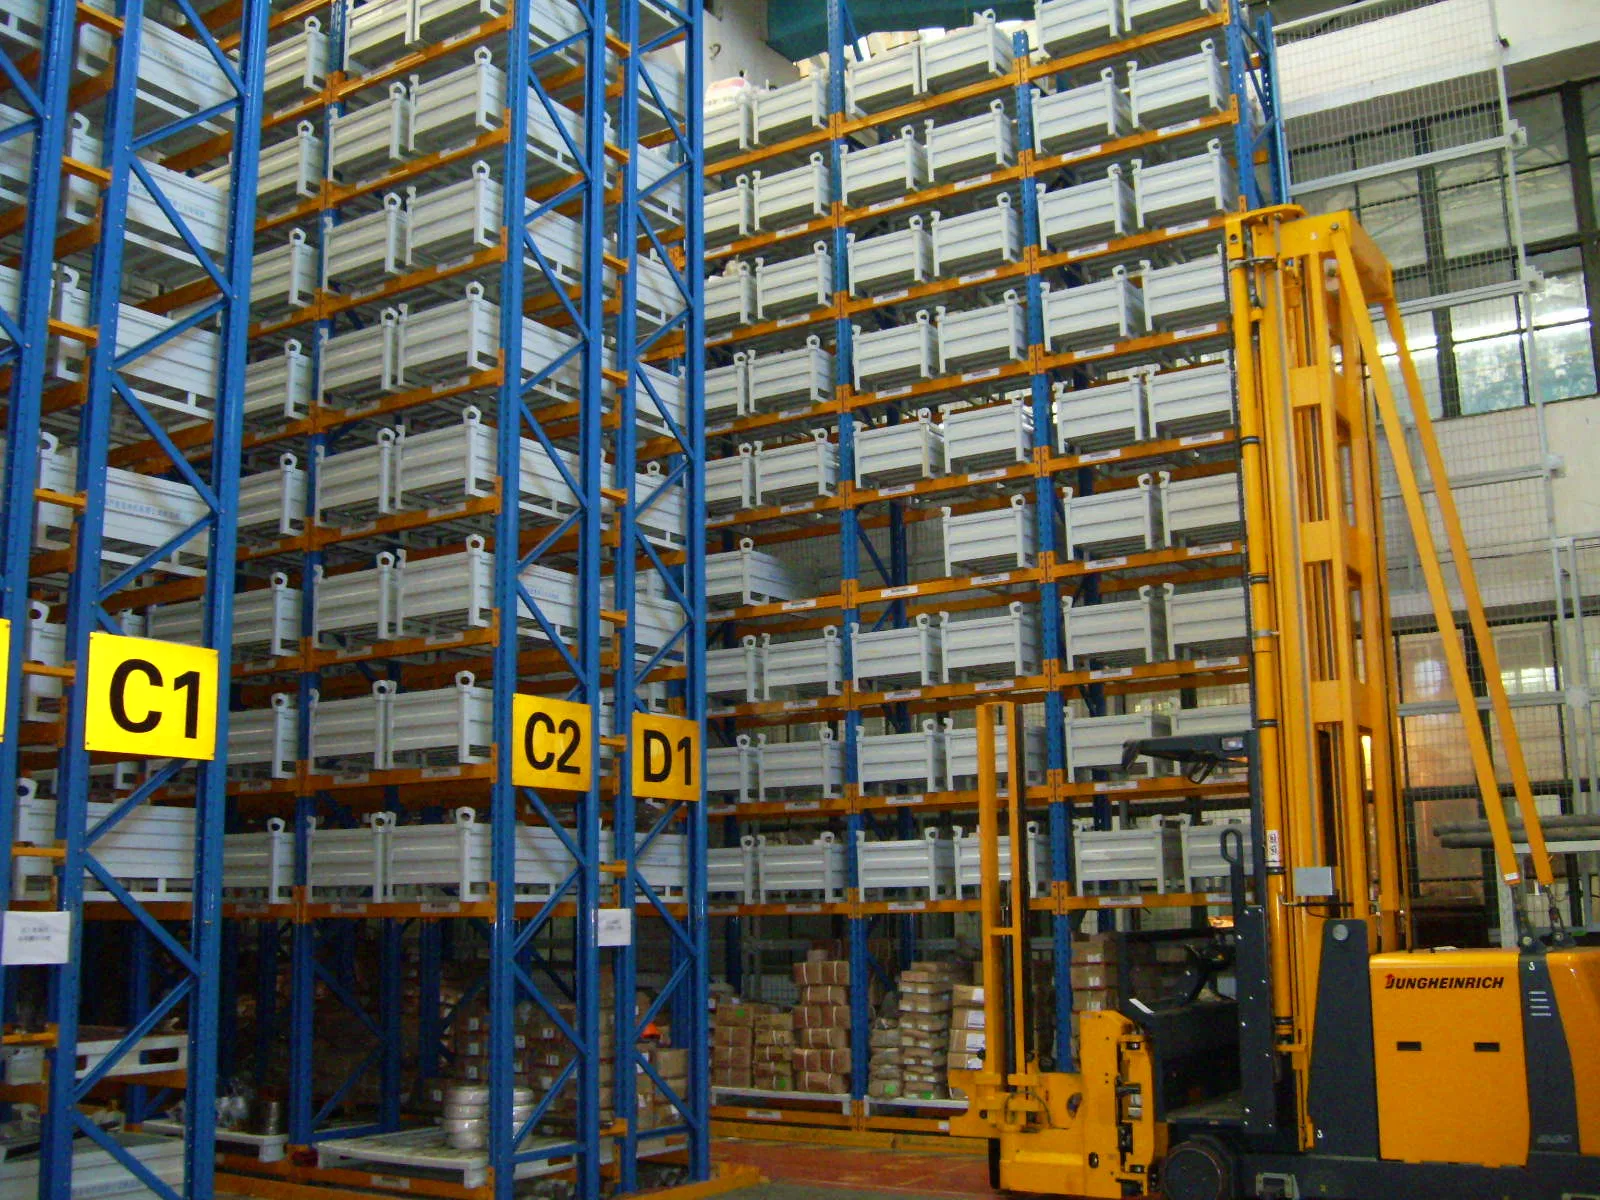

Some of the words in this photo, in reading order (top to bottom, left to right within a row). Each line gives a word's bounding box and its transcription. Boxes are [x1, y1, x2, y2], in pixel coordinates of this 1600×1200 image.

[110, 659, 200, 738] C1
[525, 712, 581, 774] C2
[643, 729, 691, 785] D1
[1385, 975, 1504, 989] JUNGHEINRICH
